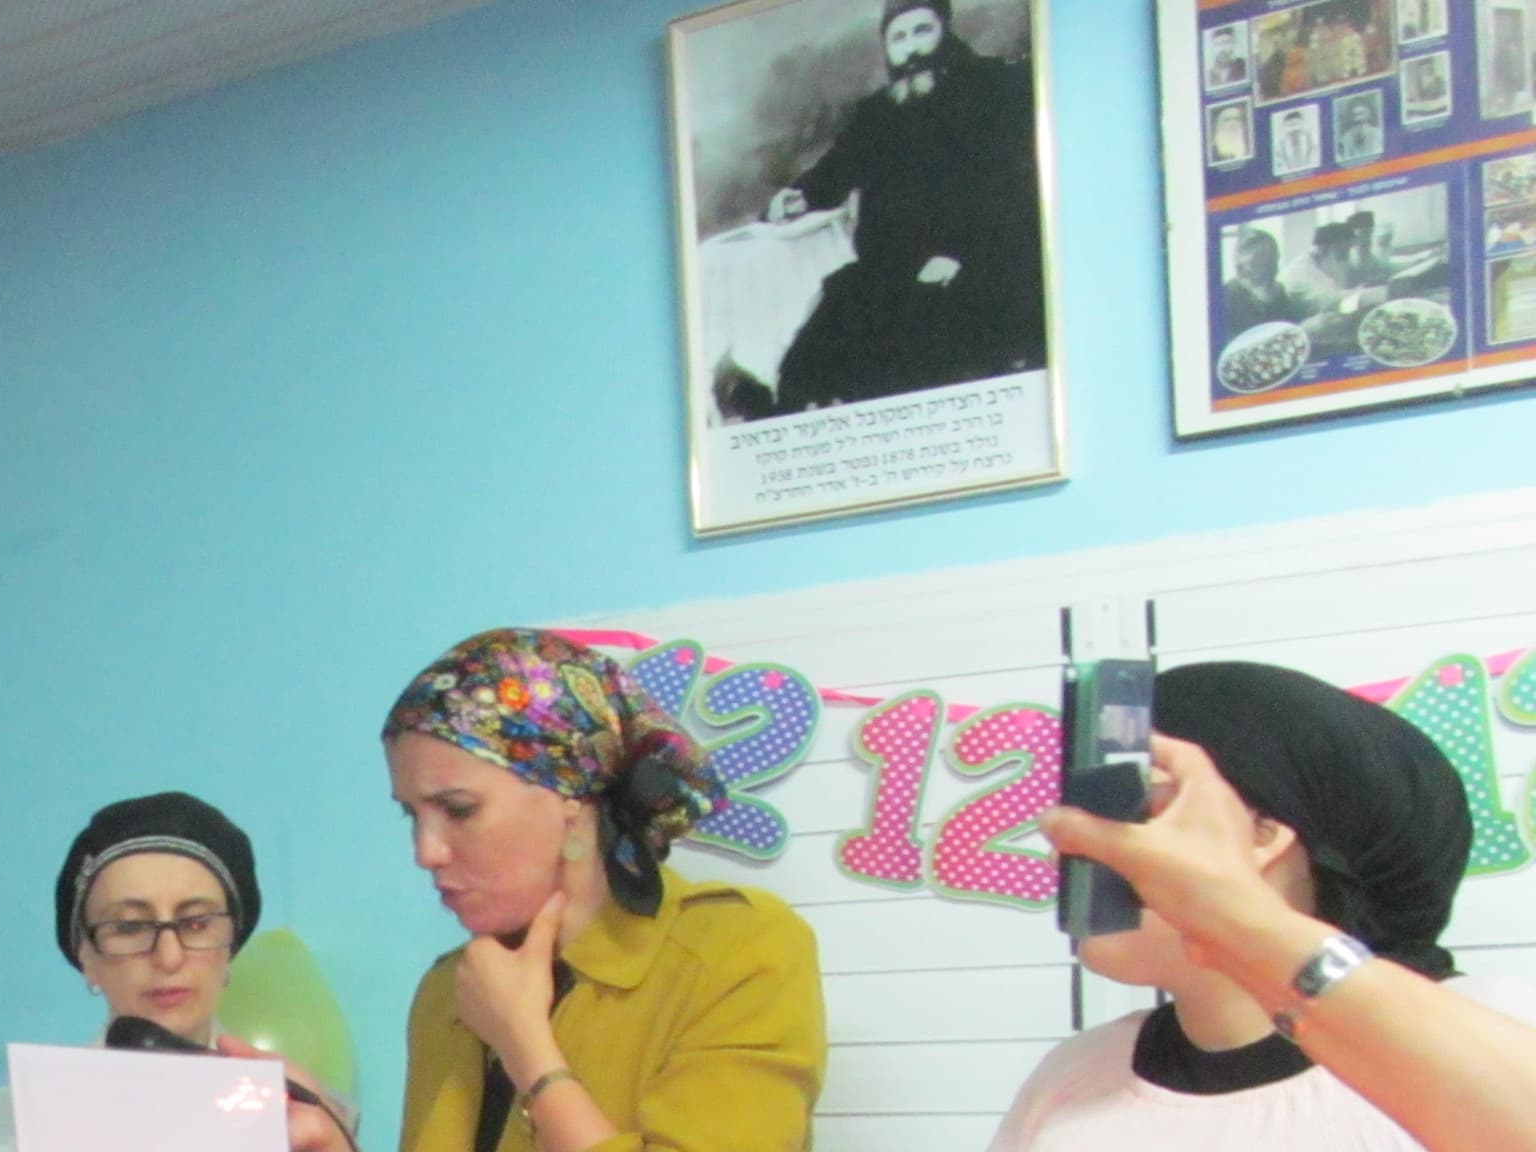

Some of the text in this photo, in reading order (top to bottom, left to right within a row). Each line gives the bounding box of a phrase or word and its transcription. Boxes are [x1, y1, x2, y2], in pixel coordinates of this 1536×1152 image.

[986, 386, 1022, 403] הרב
[952, 416, 982, 430] הרב
[835, 690, 1063, 908] 12
